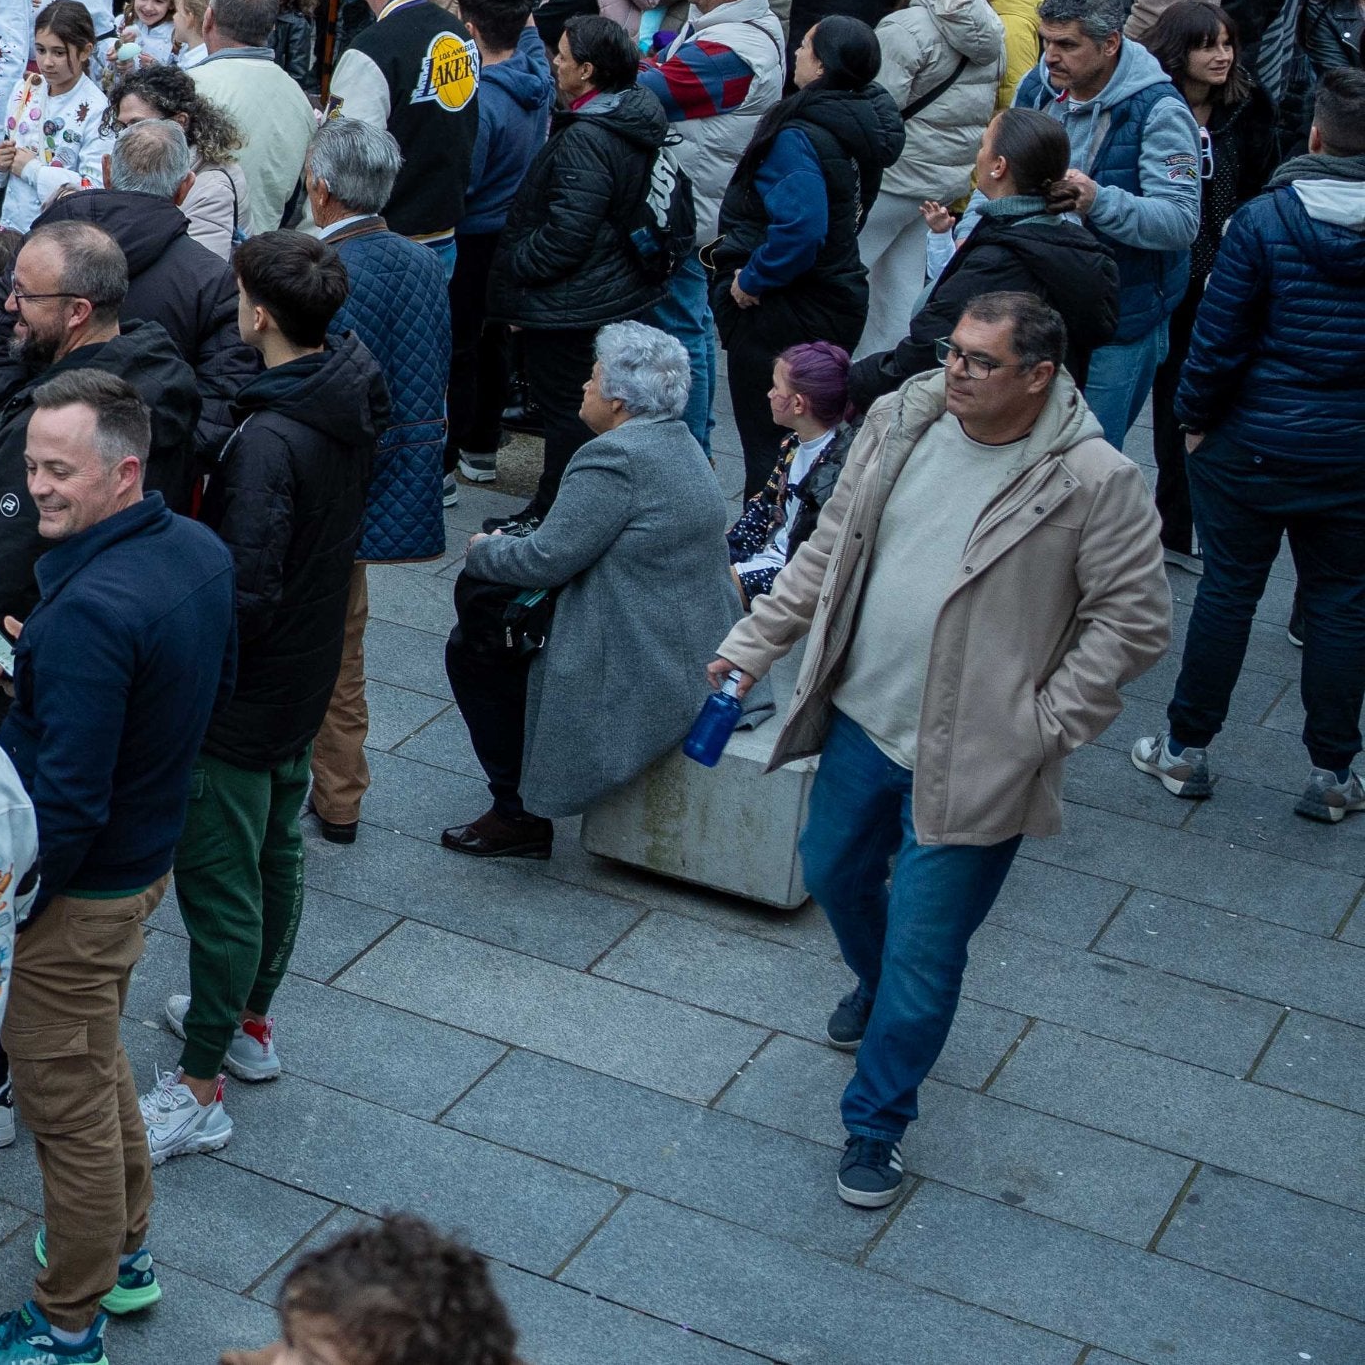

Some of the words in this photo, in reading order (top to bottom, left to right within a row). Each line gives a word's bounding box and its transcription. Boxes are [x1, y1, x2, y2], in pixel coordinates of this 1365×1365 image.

[439, 52, 451, 61] LOS
[416, 52, 479, 99] LAKERS
[269, 945, 289, 972] NIKE
